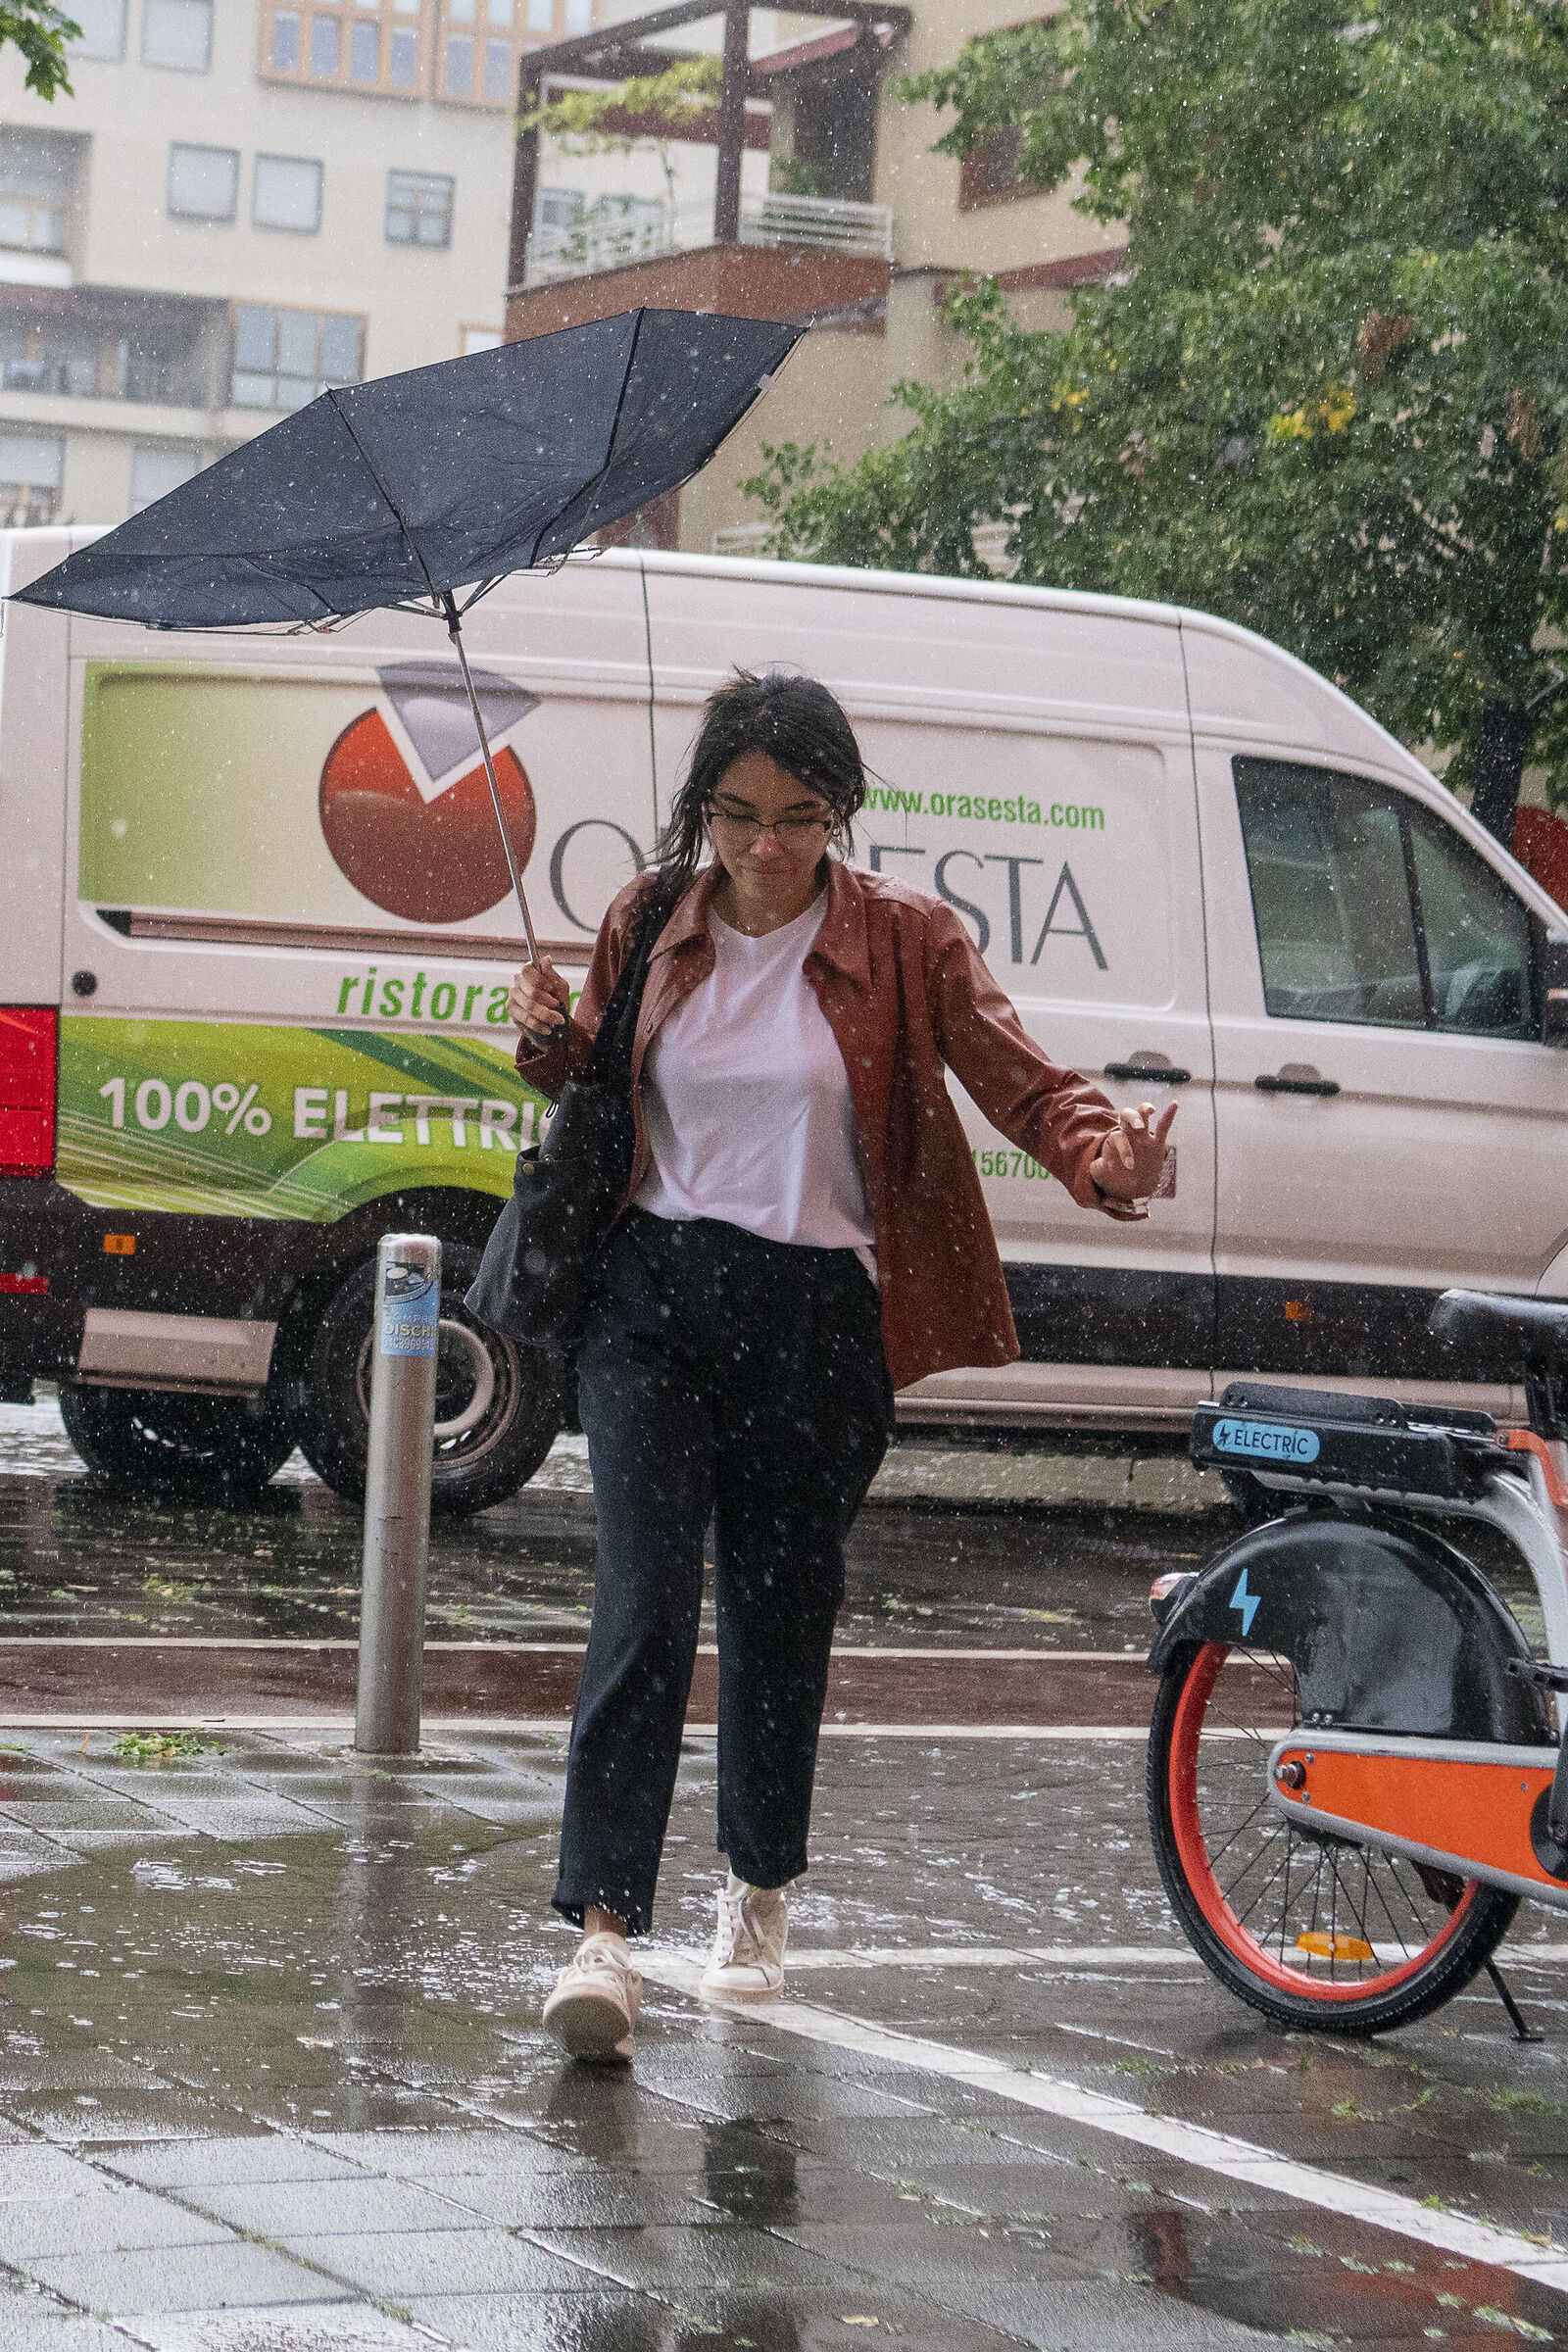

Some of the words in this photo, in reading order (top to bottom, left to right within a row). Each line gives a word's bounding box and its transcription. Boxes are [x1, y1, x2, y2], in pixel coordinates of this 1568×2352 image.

[861, 788, 1105, 830] www.orasesta.com
[337, 966, 583, 1024] ristora
[99, 1077, 272, 1137] 100%
[1234, 1428, 1309, 1455] ELECTRIC
